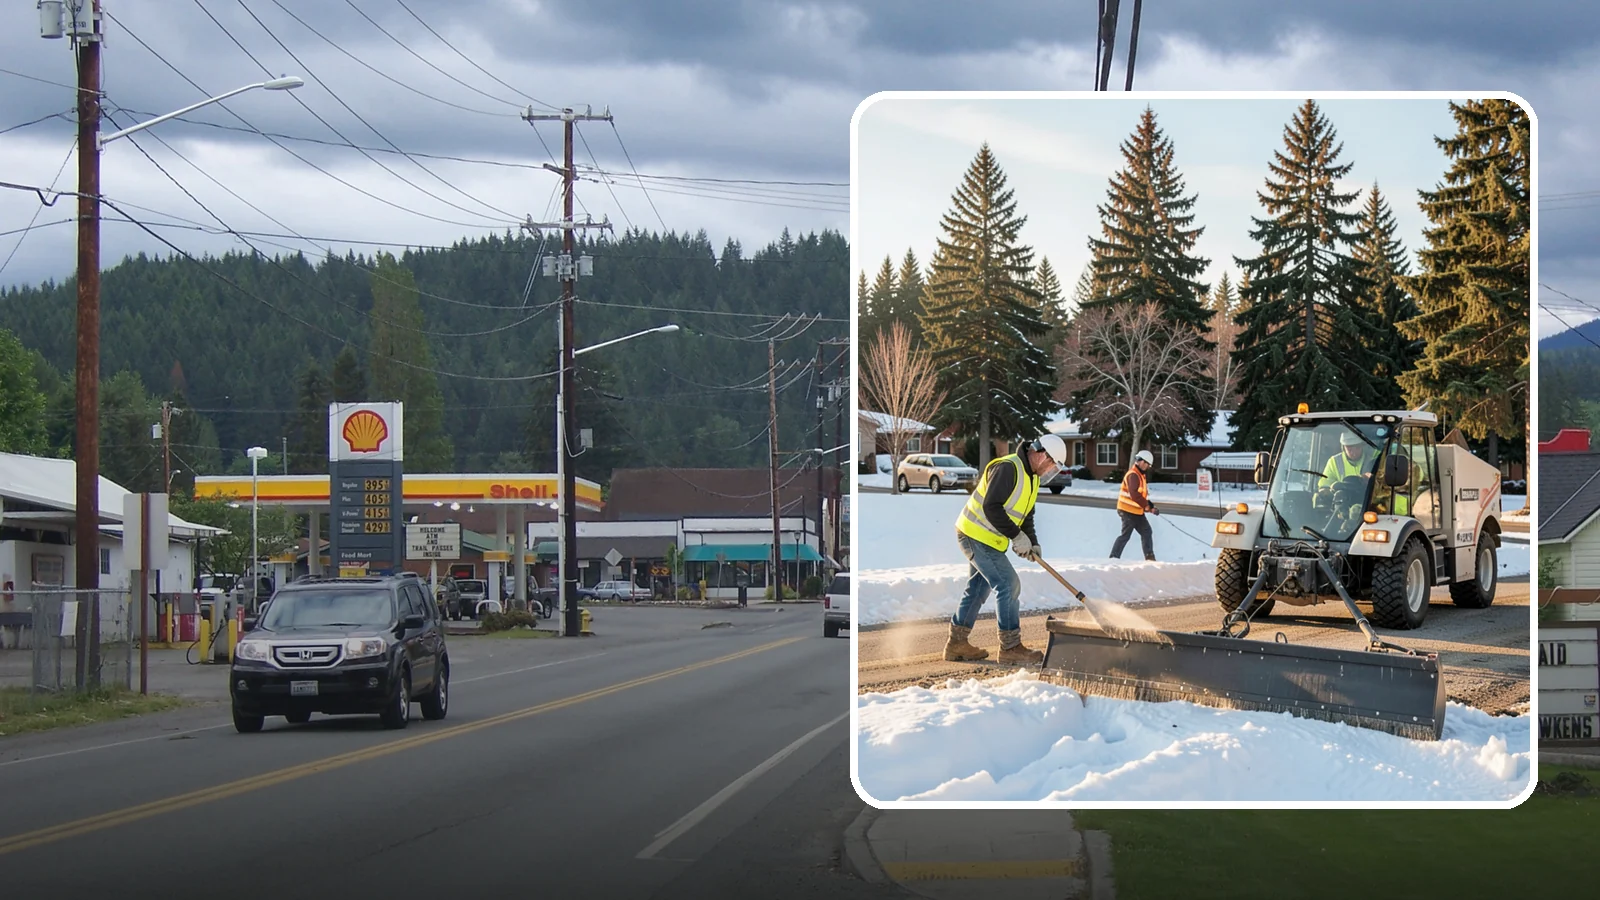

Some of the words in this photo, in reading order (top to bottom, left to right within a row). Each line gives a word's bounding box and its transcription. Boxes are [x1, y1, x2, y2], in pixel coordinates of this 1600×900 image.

[366, 480, 383, 490] 395
[490, 484, 547, 499] Shell
[366, 494, 383, 504] 405
[366, 508, 383, 518] 415
[366, 522, 383, 532] 429
